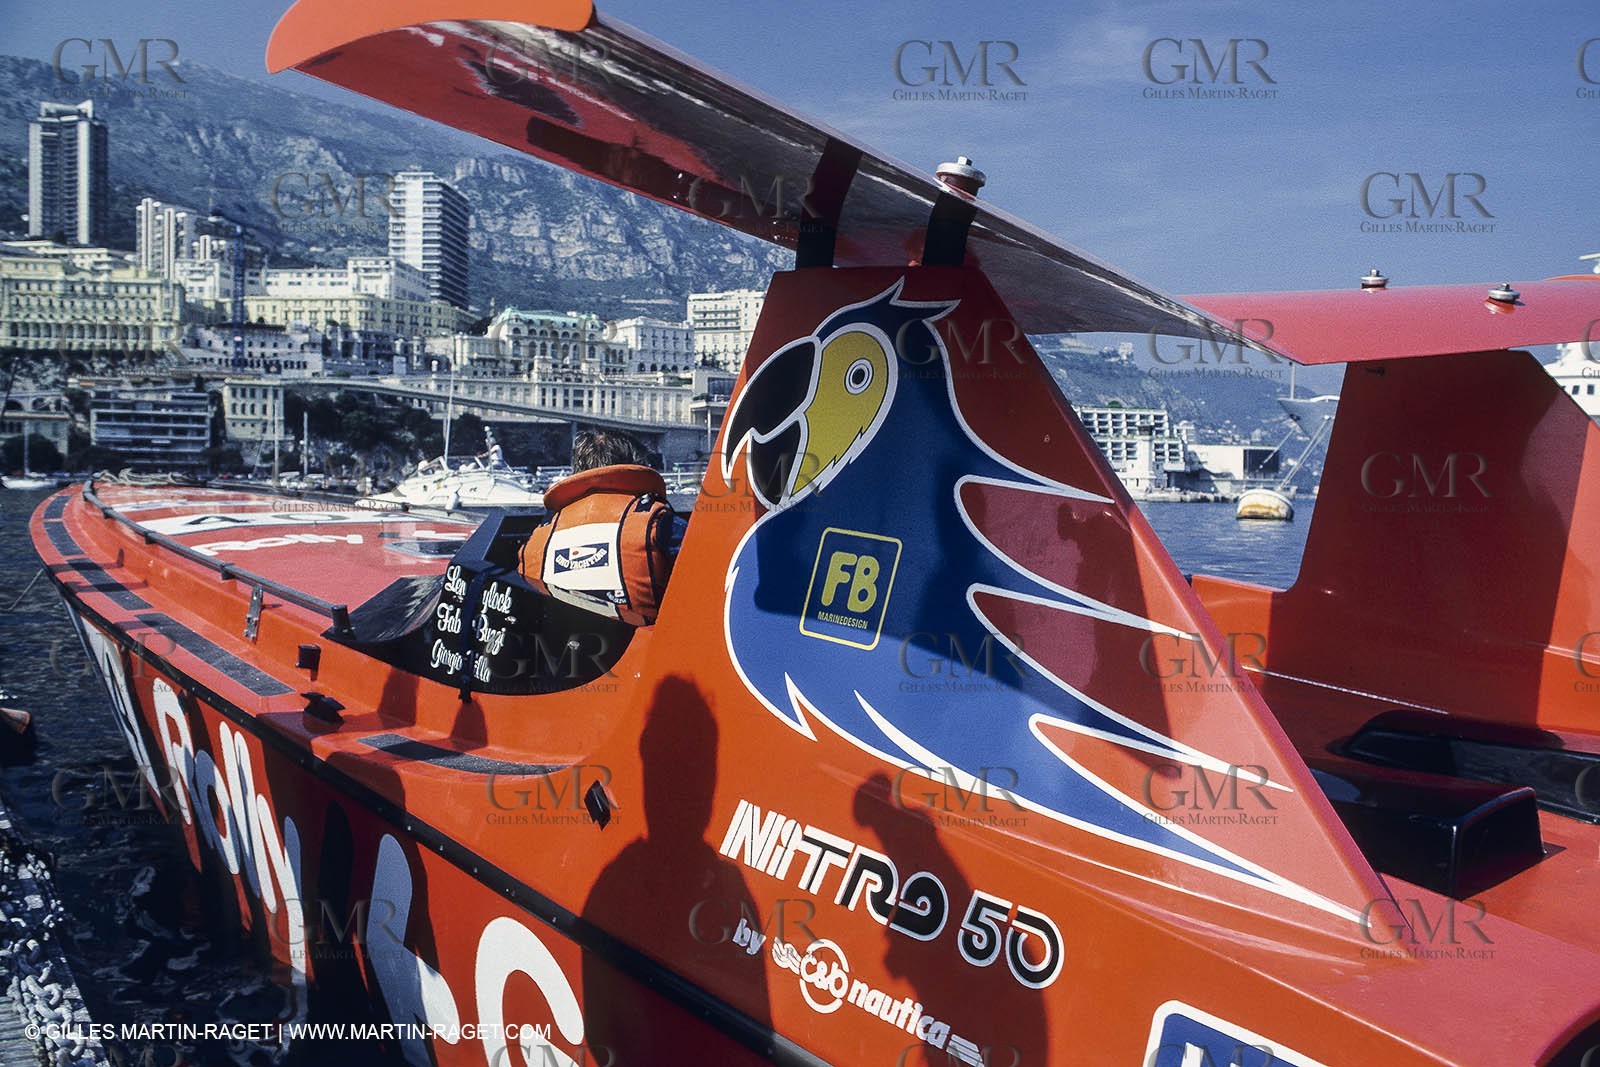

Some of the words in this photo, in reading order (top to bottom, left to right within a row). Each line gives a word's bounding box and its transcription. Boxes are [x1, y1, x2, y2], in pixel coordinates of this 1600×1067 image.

[444, 565, 467, 597] Len
[480, 581, 513, 614] ylock
[821, 551, 880, 613] FB
[436, 602, 462, 634] Fab
[817, 610, 868, 630] MARINEDESIGN
[957, 889, 1065, 990] 50
[731, 918, 766, 956] by
[847, 979, 951, 1050] nautica
